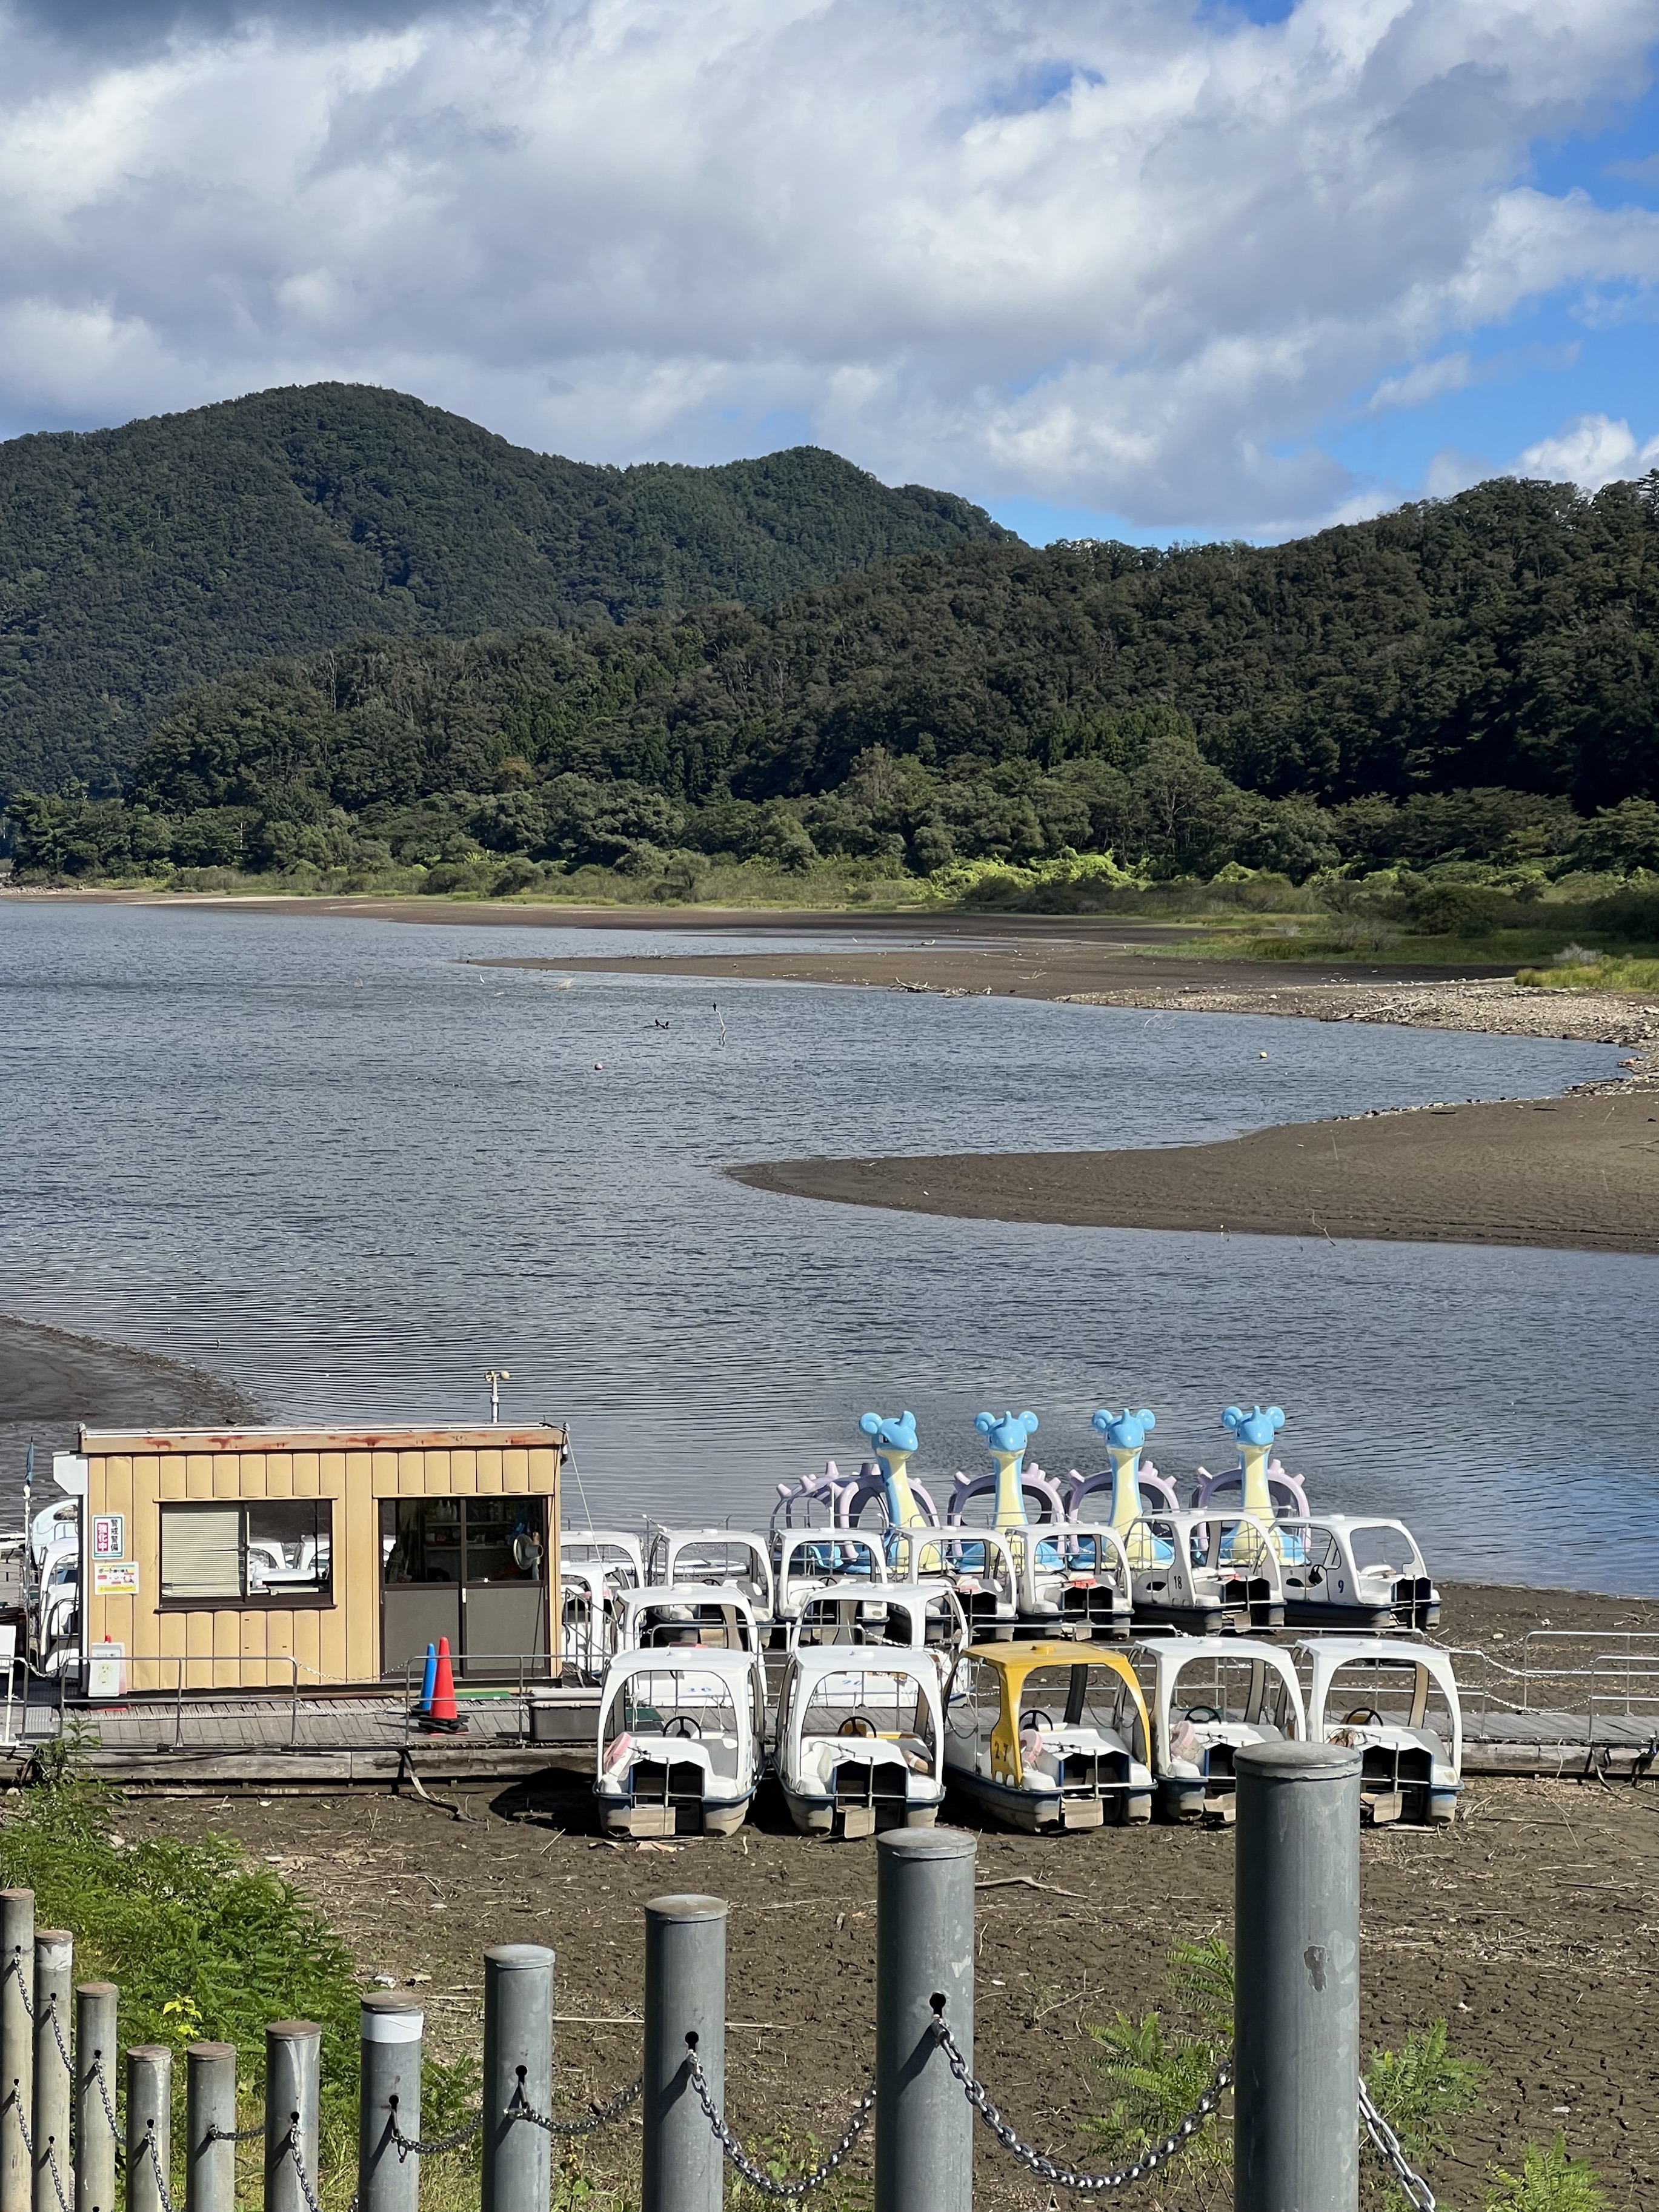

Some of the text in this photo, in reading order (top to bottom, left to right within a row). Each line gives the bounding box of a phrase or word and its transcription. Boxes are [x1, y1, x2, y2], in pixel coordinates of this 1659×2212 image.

[98, 1524, 107, 1551] 強化中
[1174, 1576, 1182, 1589] 18
[1338, 1579, 1344, 1593] 9
[994, 1740, 1009, 1762] 27
